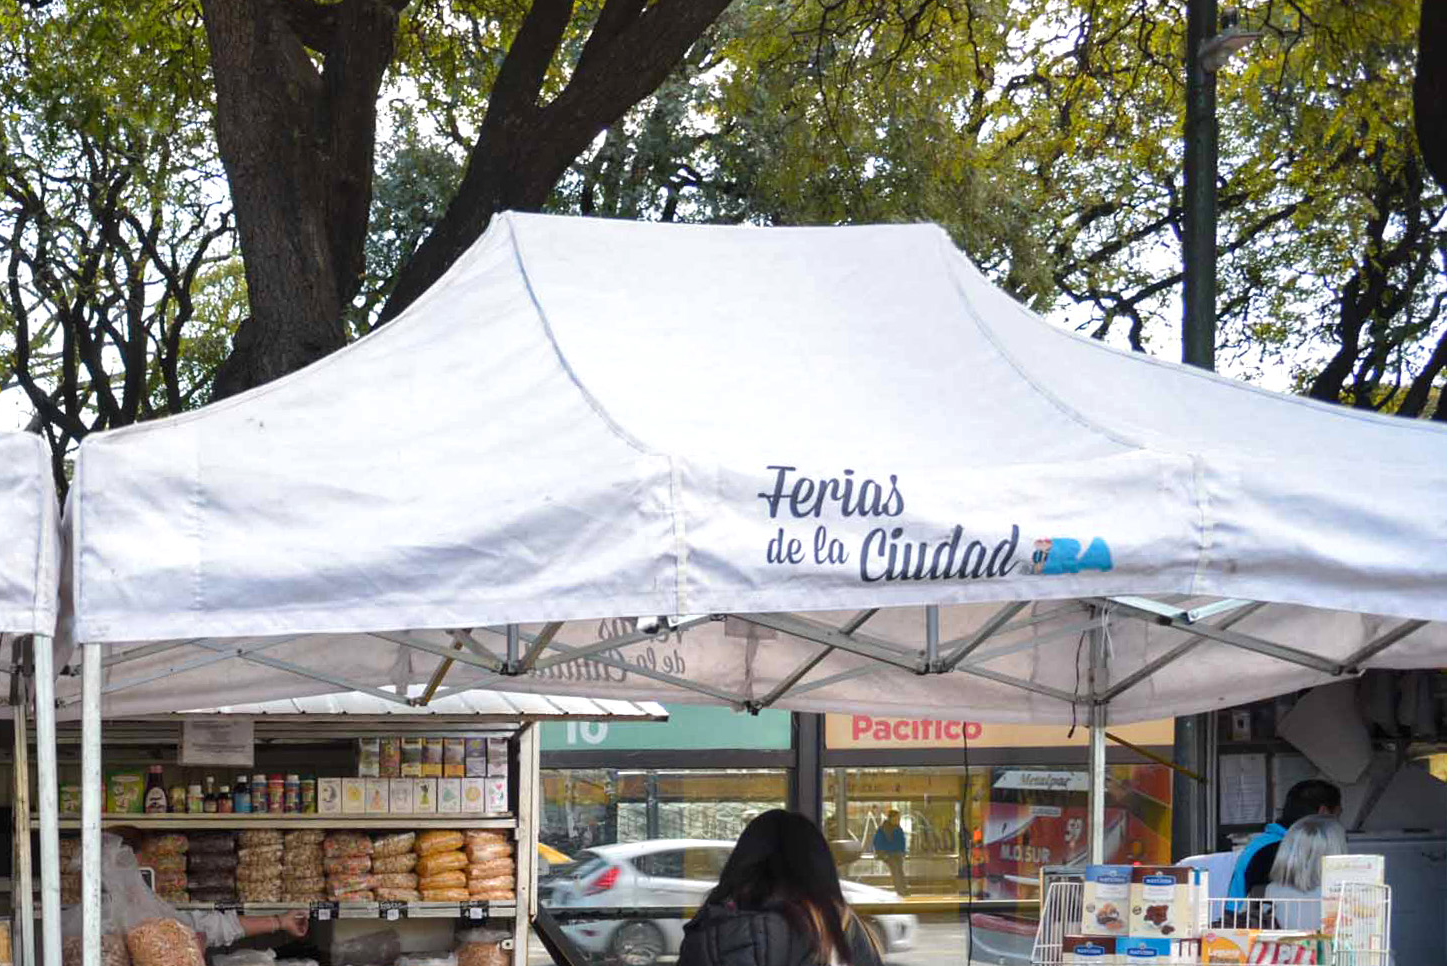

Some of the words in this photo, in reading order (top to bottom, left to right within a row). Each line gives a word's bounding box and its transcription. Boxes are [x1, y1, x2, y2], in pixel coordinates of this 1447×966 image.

[758, 465, 905, 518] Ferias
[767, 527, 804, 565] de
[815, 525, 849, 565] la
[860, 524, 1019, 583] Ciudad
